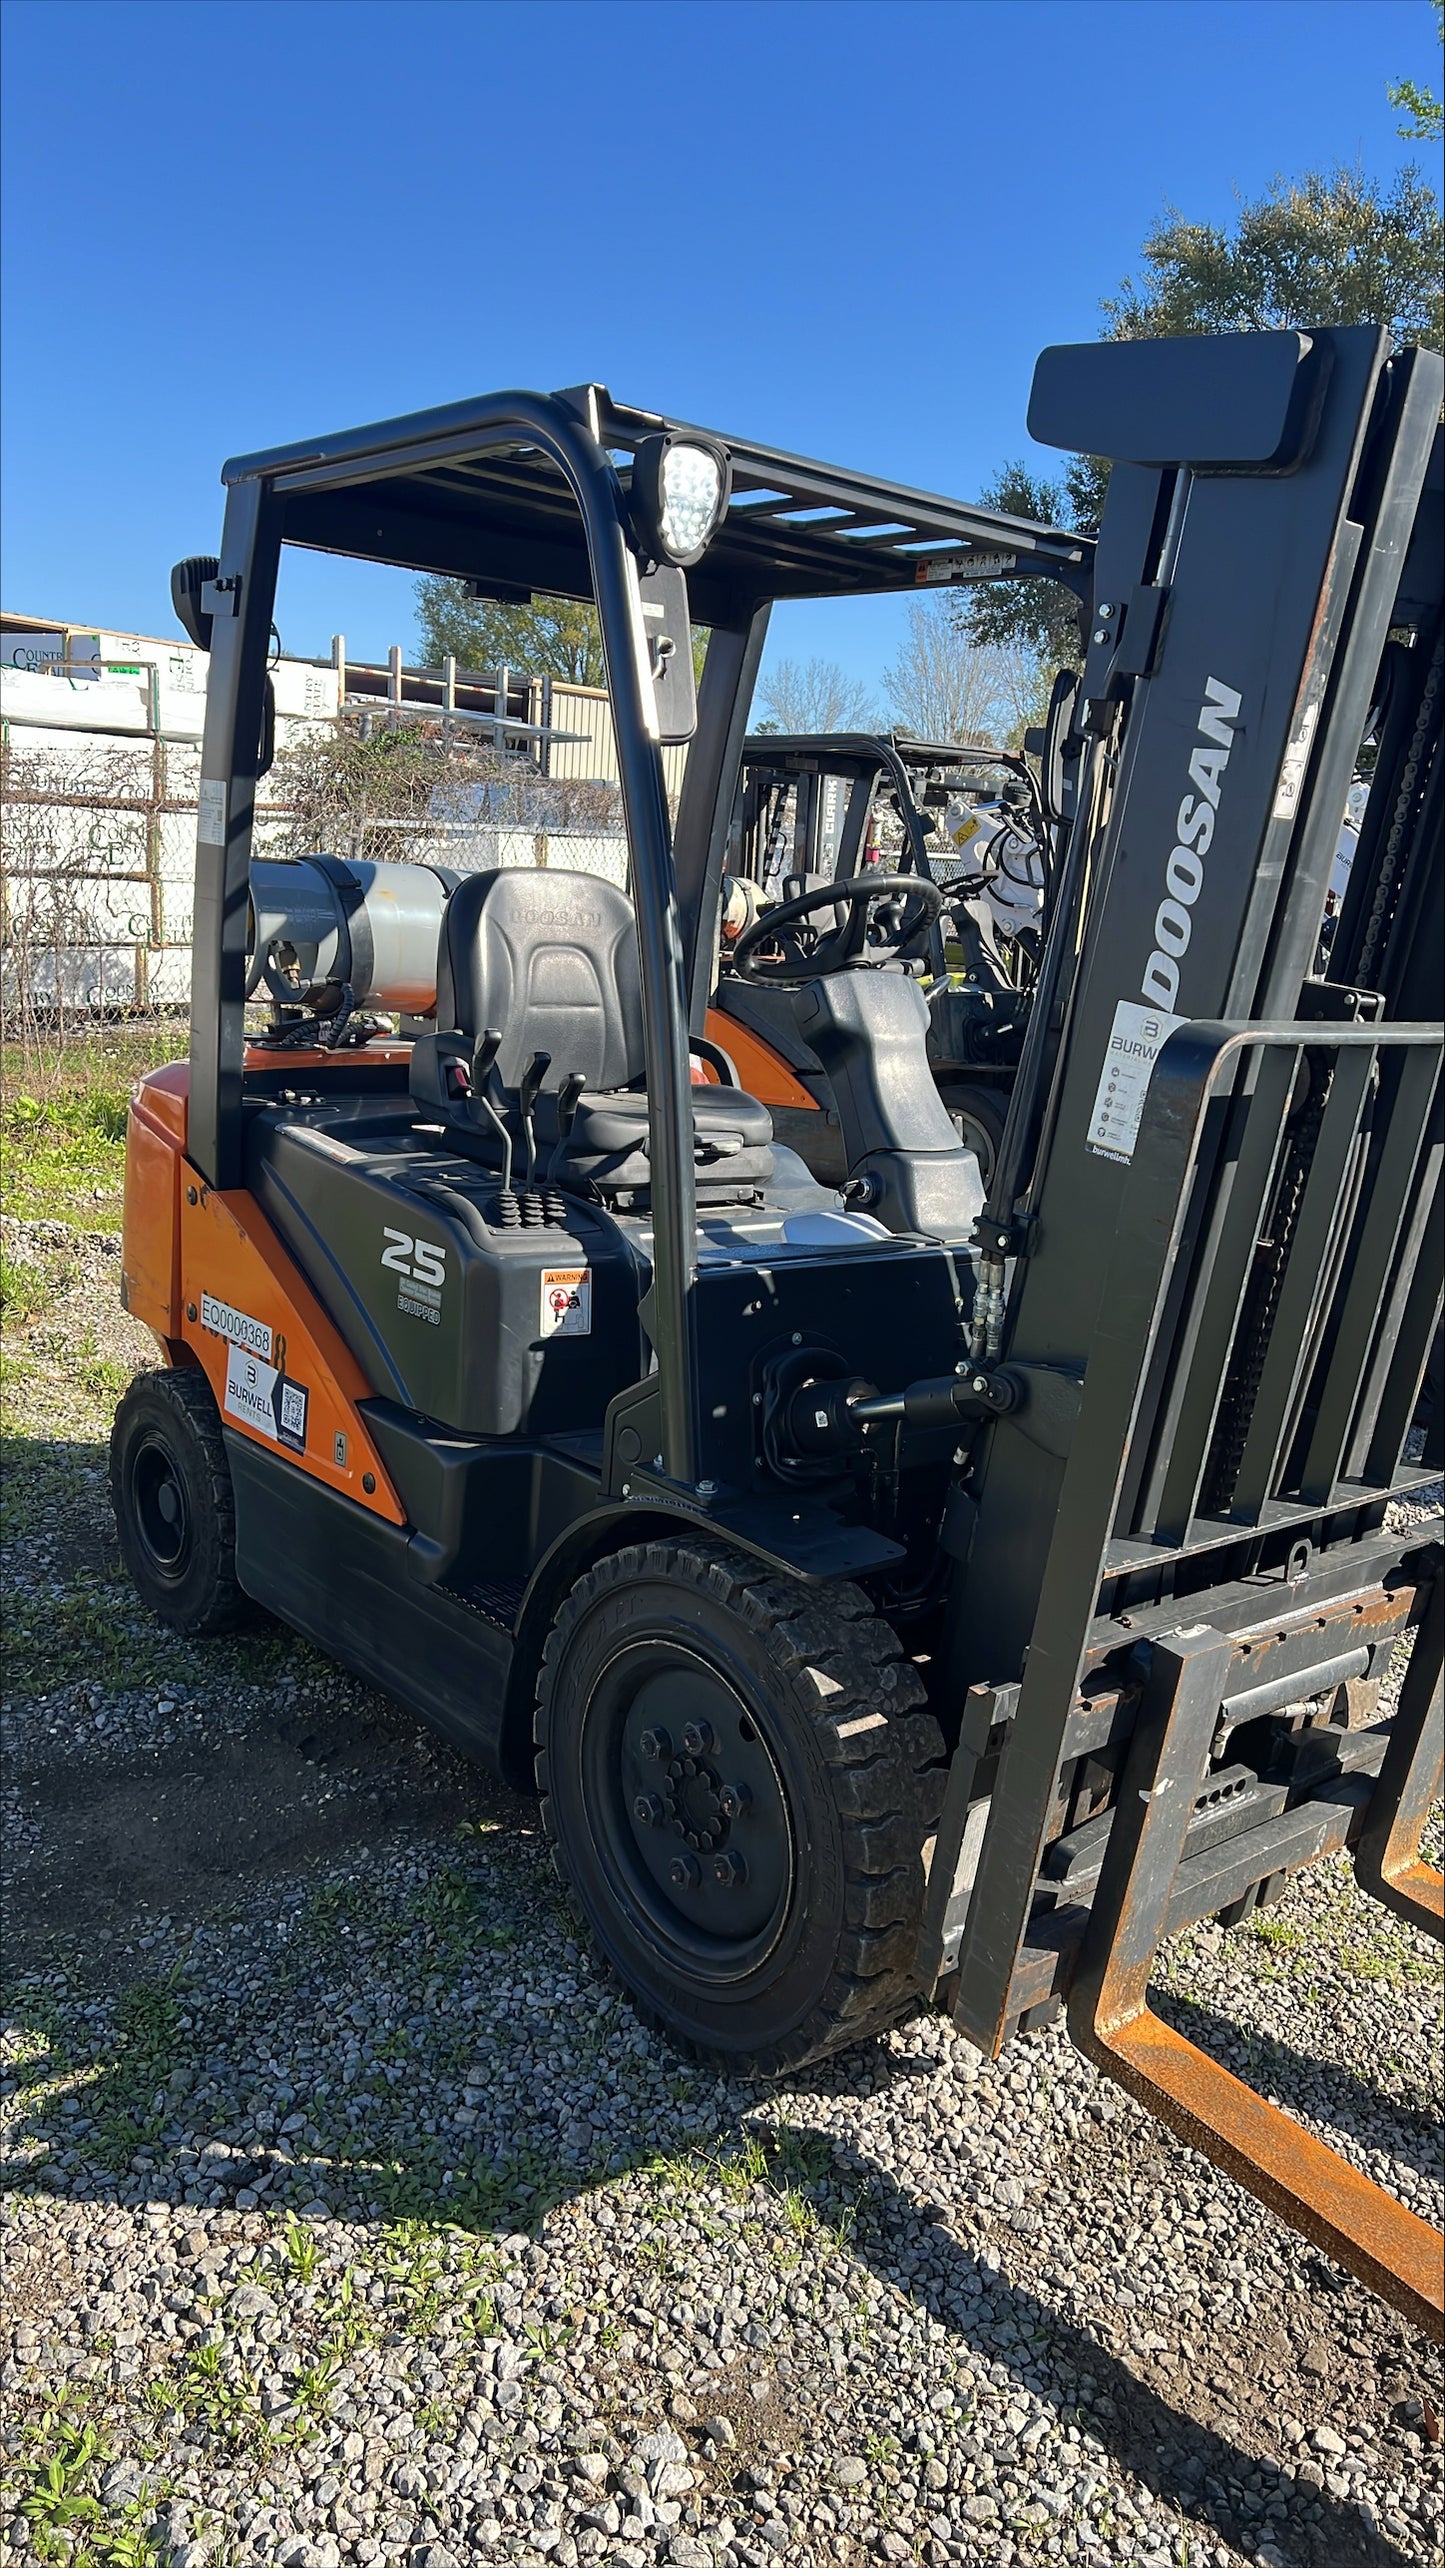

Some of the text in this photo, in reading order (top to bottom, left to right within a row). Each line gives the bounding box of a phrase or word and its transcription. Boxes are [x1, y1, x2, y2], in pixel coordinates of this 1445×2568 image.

[13, 648, 63, 669] COUNTR
[825, 779, 838, 834] CLARK
[89, 824, 146, 849] COUN
[1141, 676, 1242, 1014] DOOSAN
[1336, 851, 1352, 869] BUR
[510, 909, 601, 927] DOOSAN
[86, 981, 162, 1007] COUNY
[1111, 1036, 1158, 1061] BURW
[381, 1226, 446, 1287] 25
[555, 1269, 588, 1281] WARNING
[397, 1294, 441, 1325] EQUIPPED
[202, 1299, 270, 1352] EQ0000368
[228, 1379, 272, 1418] BURWELL
